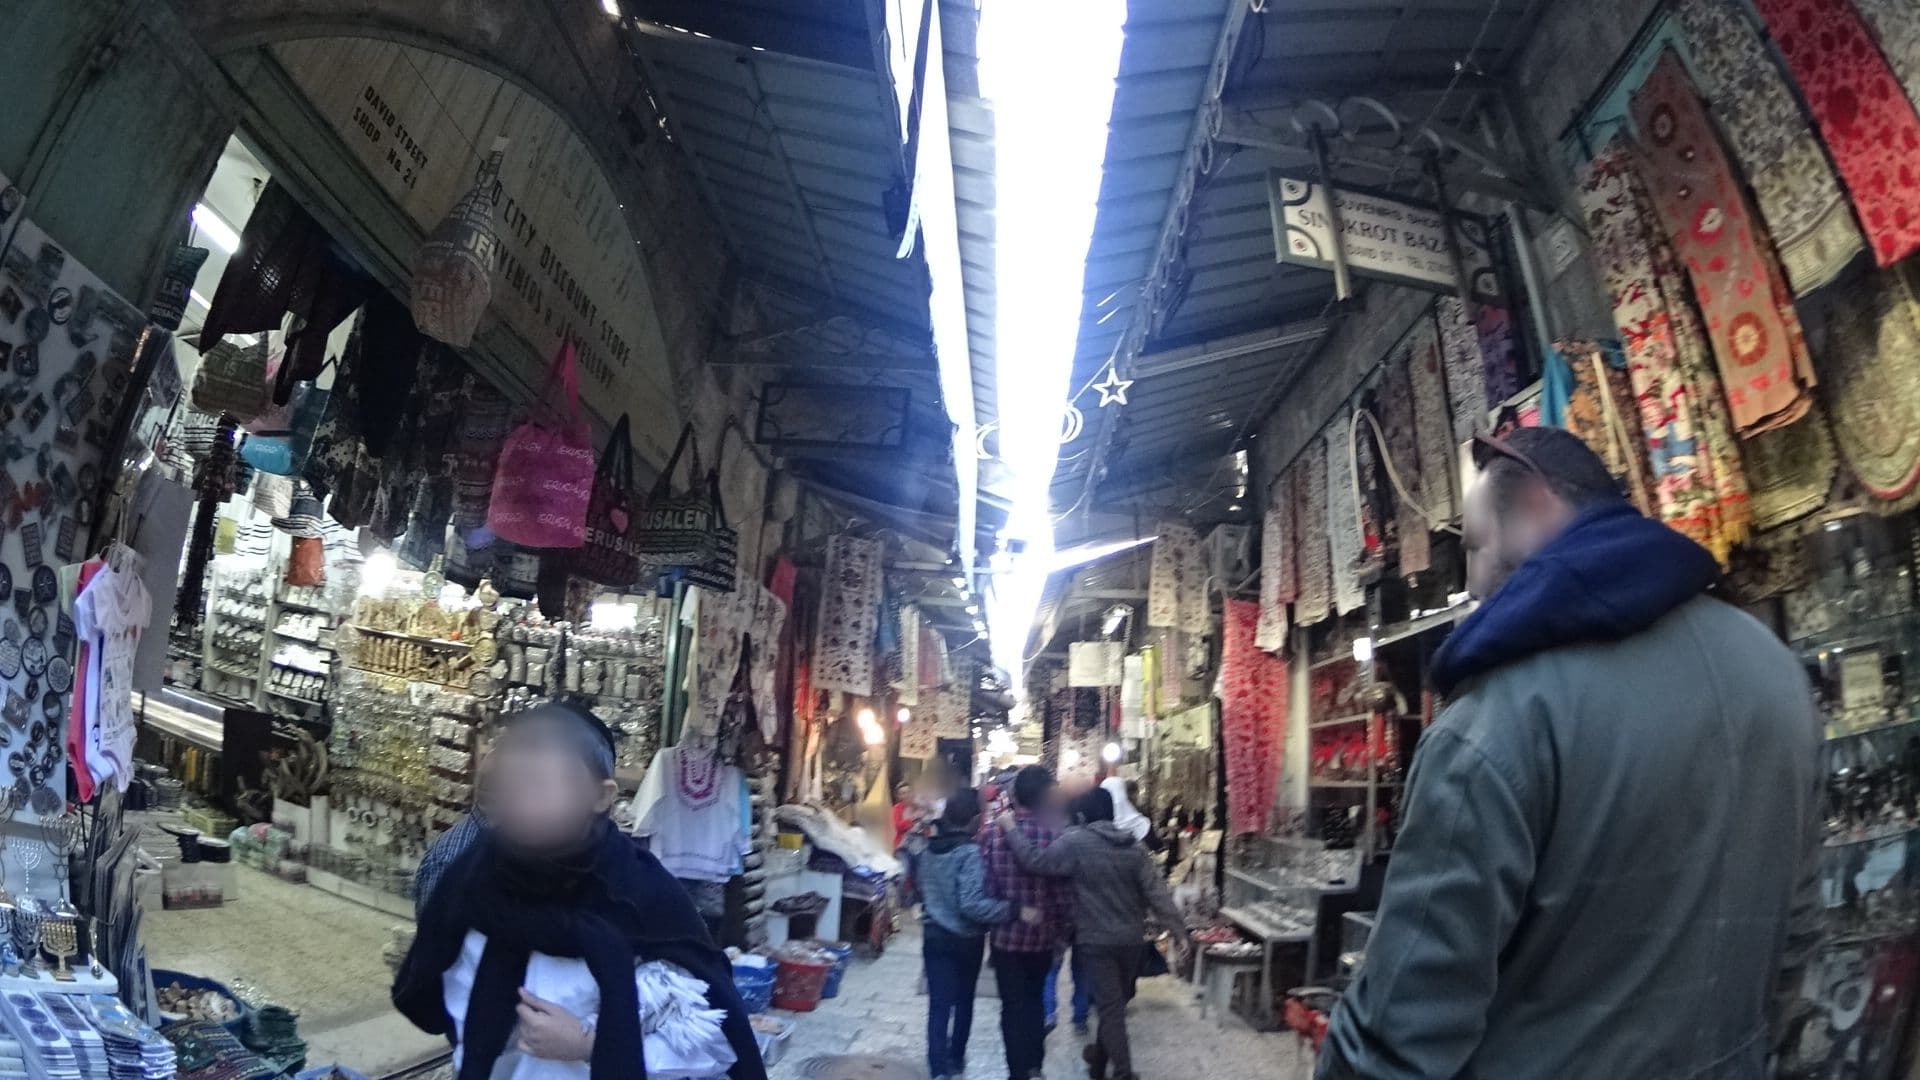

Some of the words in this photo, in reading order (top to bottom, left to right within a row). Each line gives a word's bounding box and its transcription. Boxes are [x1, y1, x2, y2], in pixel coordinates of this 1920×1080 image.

[353, 107, 381, 143] SHOP
[365, 86, 396, 128] DAVID
[395, 124, 428, 168] STREET
[1403, 231, 1478, 259] BAZR
[492, 238, 543, 314] VENIRS
[504, 197, 537, 247] CITY
[540, 244, 597, 327] DISCOUNT
[601, 319, 631, 368] STORE
[640, 509, 709, 530] USALEM
[585, 525, 641, 555] ERUSALE
